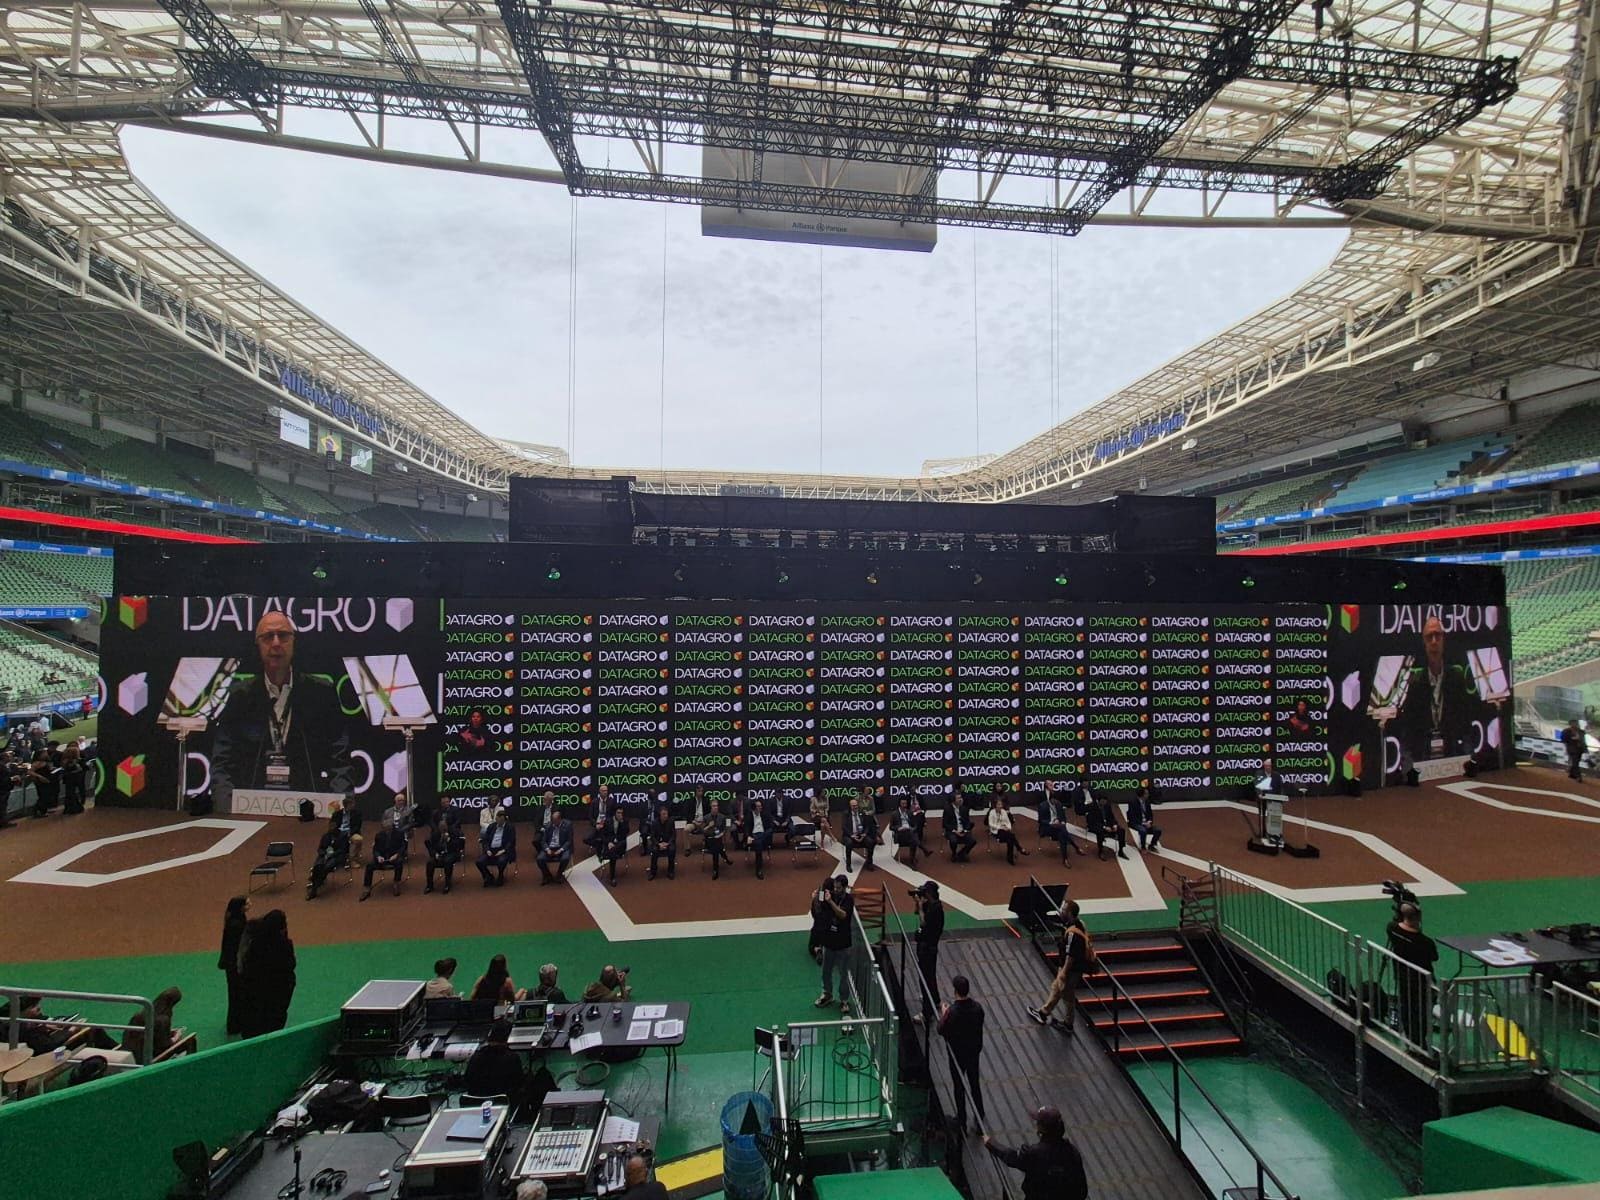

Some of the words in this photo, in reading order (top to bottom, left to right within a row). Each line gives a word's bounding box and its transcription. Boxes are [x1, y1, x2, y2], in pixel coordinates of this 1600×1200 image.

[183, 597, 376, 632] DATAGRO
[521, 615, 581, 625] DATAGRO
[599, 615, 657, 625] DATAGRO
[675, 615, 731, 625] DATAGRO
[750, 616, 804, 625] DATAGRO
[821, 616, 875, 626] DATAGRO
[890, 616, 943, 626] DATAGRO
[958, 616, 1009, 626] DATAGRO
[1025, 617, 1074, 626] DATAGRO
[1089, 617, 1138, 626] DATAGRO
[1152, 617, 1199, 626] DATAGRO
[1214, 617, 1260, 626] DATAGRO
[1275, 617, 1321, 627] DATAGRO
[1380, 604, 1482, 634] DATAGRO
[521, 633, 581, 642] DATAGRO
[599, 632, 657, 642] DATAGRO
[675, 633, 731, 642] DATAGRO
[749, 633, 804, 642] DATAGRO
[821, 633, 875, 642] DATAGRO
[890, 633, 943, 642] DATAGRO
[958, 633, 1010, 642] DATAGRO
[1025, 633, 1075, 642] DATAGRO
[1089, 633, 1138, 642] DATAGRO
[1152, 632, 1200, 642] DATAGRO
[1214, 633, 1261, 642] DATAGRO
[1276, 633, 1322, 642] DATAGRO
[521, 651, 581, 661] DATAGRO
[599, 650, 657, 661] DATAGRO
[675, 650, 731, 661] DATAGRO
[749, 650, 804, 660] DATAGRO
[820, 650, 875, 660] DATAGRO
[890, 650, 943, 660] DATAGRO
[958, 650, 1010, 659] DATAGRO
[1025, 649, 1075, 659] DATAGRO
[1089, 649, 1138, 659] DATAGRO
[1152, 648, 1200, 659] DATAGRO
[1214, 649, 1261, 658] DATAGRO
[1276, 648, 1322, 658] DATAGRO
[520, 669, 581, 679] DATAGRO
[598, 668, 657, 678] DATAGRO
[675, 668, 731, 678] DATAGRO
[749, 667, 804, 678] DATAGRO
[820, 667, 875, 677] DATAGRO
[890, 666, 943, 676] DATAGRO
[958, 666, 1010, 676] DATAGRO
[1025, 666, 1075, 675] DATAGRO
[1089, 665, 1138, 675] DATAGRO
[1152, 664, 1201, 674] DATAGRO
[1214, 664, 1261, 674] DATAGRO
[1276, 664, 1322, 673] DATAGRO
[520, 687, 580, 696] DATAGRO
[598, 686, 657, 695] DATAGRO
[674, 685, 731, 695] DATAGRO
[749, 685, 804, 694] DATAGRO
[820, 684, 875, 693] DATAGRO
[890, 683, 943, 693] DATAGRO
[958, 683, 1010, 692] DATAGRO
[1025, 682, 1075, 691] DATAGRO
[1090, 681, 1138, 690] DATAGRO
[1153, 680, 1201, 690] DATAGRO
[1214, 680, 1262, 689] DATAGRO
[1276, 679, 1322, 688] DATAGRO
[520, 704, 580, 714] DATAGRO
[598, 703, 657, 713] DATAGRO
[674, 702, 731, 712] DATAGRO
[749, 702, 804, 711] DATAGRO
[820, 701, 875, 710] DATAGRO
[890, 700, 943, 709] DATAGRO
[958, 699, 1010, 708] DATAGRO
[1025, 698, 1075, 707] DATAGRO
[1090, 697, 1139, 706] DATAGRO
[1153, 696, 1201, 706] DATAGRO
[1215, 696, 1262, 705] DATAGRO
[520, 723, 580, 733] DATAGRO
[598, 721, 657, 731] DATAGRO
[674, 720, 731, 730] DATAGRO
[748, 719, 804, 729] DATAGRO
[820, 718, 875, 728] DATAGRO
[890, 717, 943, 727] DATAGRO
[958, 716, 1010, 726] DATAGRO
[1025, 715, 1075, 725] DATAGRO
[1090, 714, 1139, 723] DATAGRO
[1153, 712, 1202, 722] DATAGRO
[1215, 712, 1262, 721] DATAGRO
[520, 740, 580, 750] DATAGRO
[598, 739, 656, 749] DATAGRO
[674, 738, 731, 747] DATAGRO
[748, 737, 804, 746] DATAGRO
[820, 735, 875, 745] DATAGRO
[890, 734, 943, 743] DATAGRO
[958, 732, 1010, 742] DATAGRO
[1025, 731, 1075, 740] DATAGRO
[1090, 730, 1139, 739] DATAGRO
[1153, 728, 1202, 738] DATAGRO
[1215, 727, 1263, 737] DATAGRO
[520, 759, 580, 769] DATAGRO
[597, 757, 656, 767] DATAGRO
[674, 755, 731, 765] DATAGRO
[748, 754, 804, 764] DATAGRO
[820, 752, 875, 762] DATAGRO
[890, 751, 943, 761] DATAGRO
[958, 749, 1010, 759] DATAGRO
[1025, 748, 1076, 758] DATAGRO
[1090, 746, 1139, 756] DATAGRO
[1153, 744, 1202, 755] DATAGRO
[1215, 743, 1263, 753] DATAGRO
[1276, 742, 1322, 751] DATAGRO
[519, 777, 580, 787] DATAGRO
[597, 775, 656, 786] DATAGRO
[674, 773, 731, 783] DATAGRO
[748, 771, 804, 781] DATAGRO
[820, 769, 875, 779] DATAGRO
[890, 767, 943, 777] DATAGRO
[958, 766, 1010, 776] DATAGRO
[1025, 764, 1076, 774] DATAGRO
[1090, 763, 1139, 772] DATAGRO
[1153, 760, 1203, 770] DATAGRO
[1215, 759, 1263, 769] DATAGRO
[1276, 757, 1322, 767] DATAGRO
[519, 795, 579, 806] DATGRO
